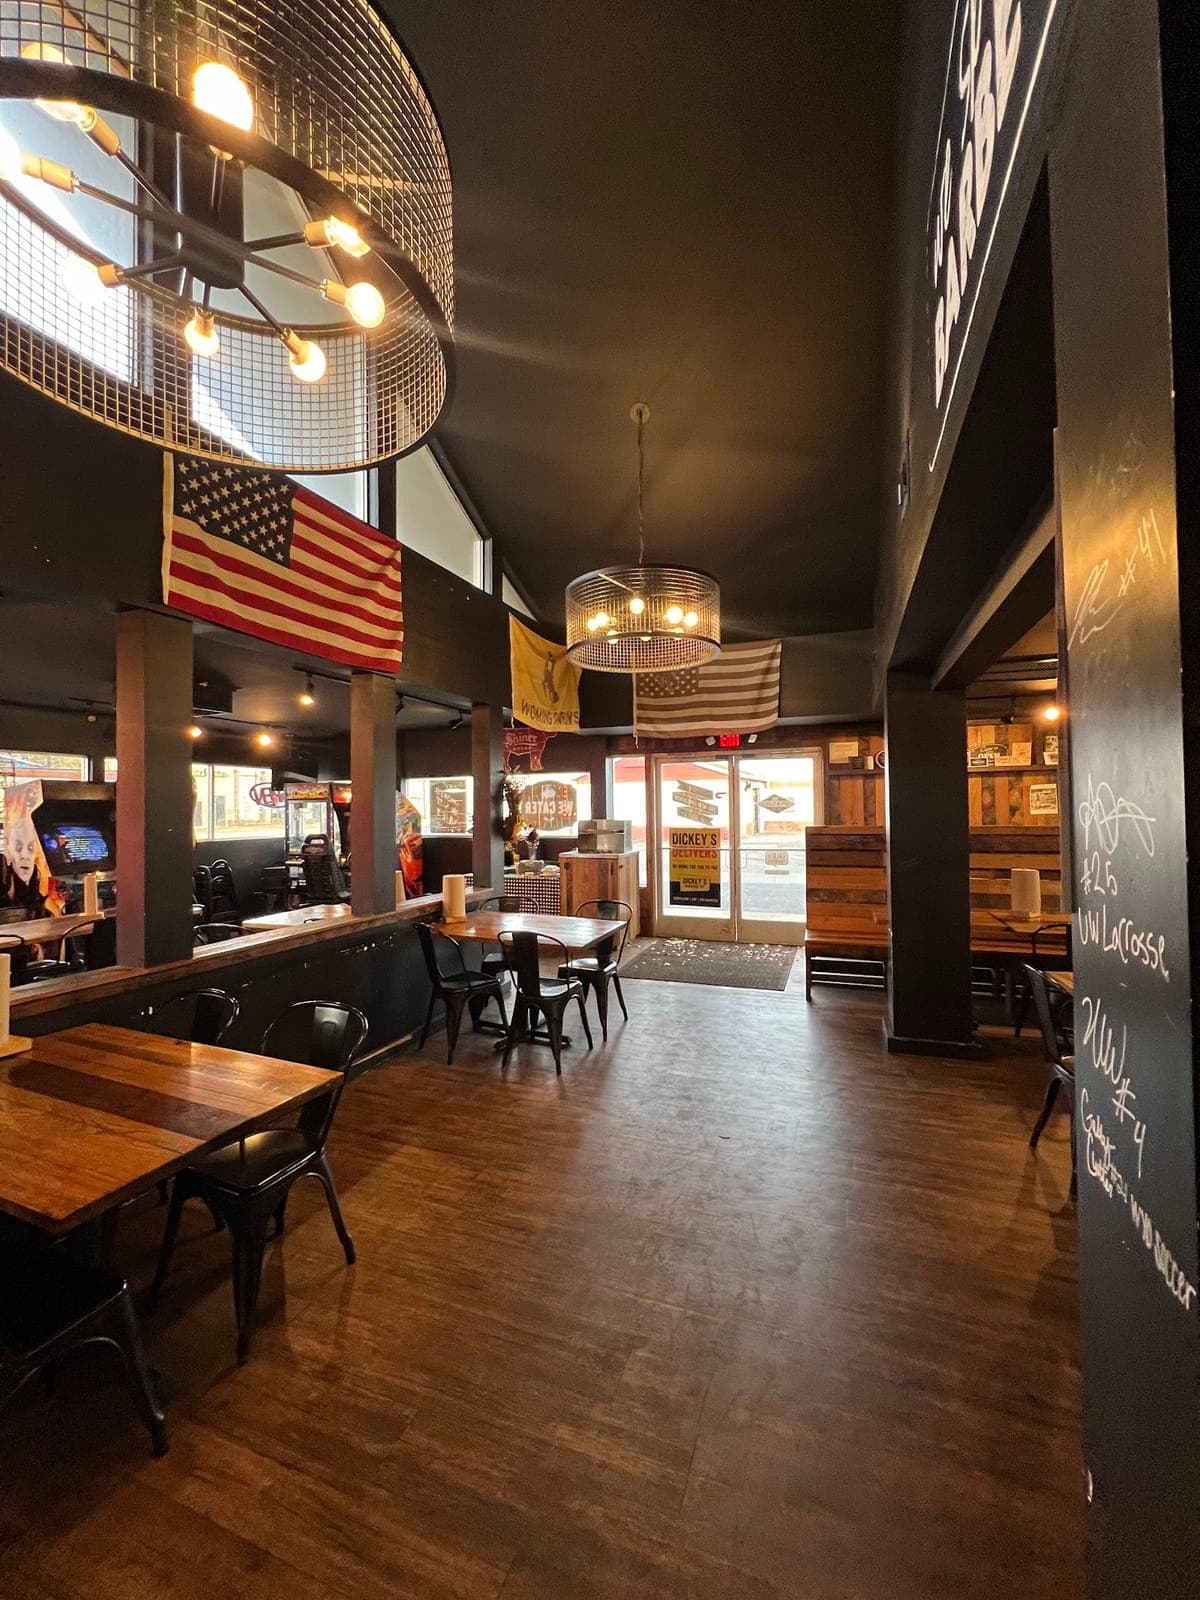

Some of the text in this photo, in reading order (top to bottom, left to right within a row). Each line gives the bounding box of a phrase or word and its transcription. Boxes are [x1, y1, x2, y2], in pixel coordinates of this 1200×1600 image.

[504, 732, 538, 748] Shiner
[672, 833, 717, 846] DICKEY'S
[672, 846, 718, 859] DELIVERS
[1080, 850, 1118, 897] #25
